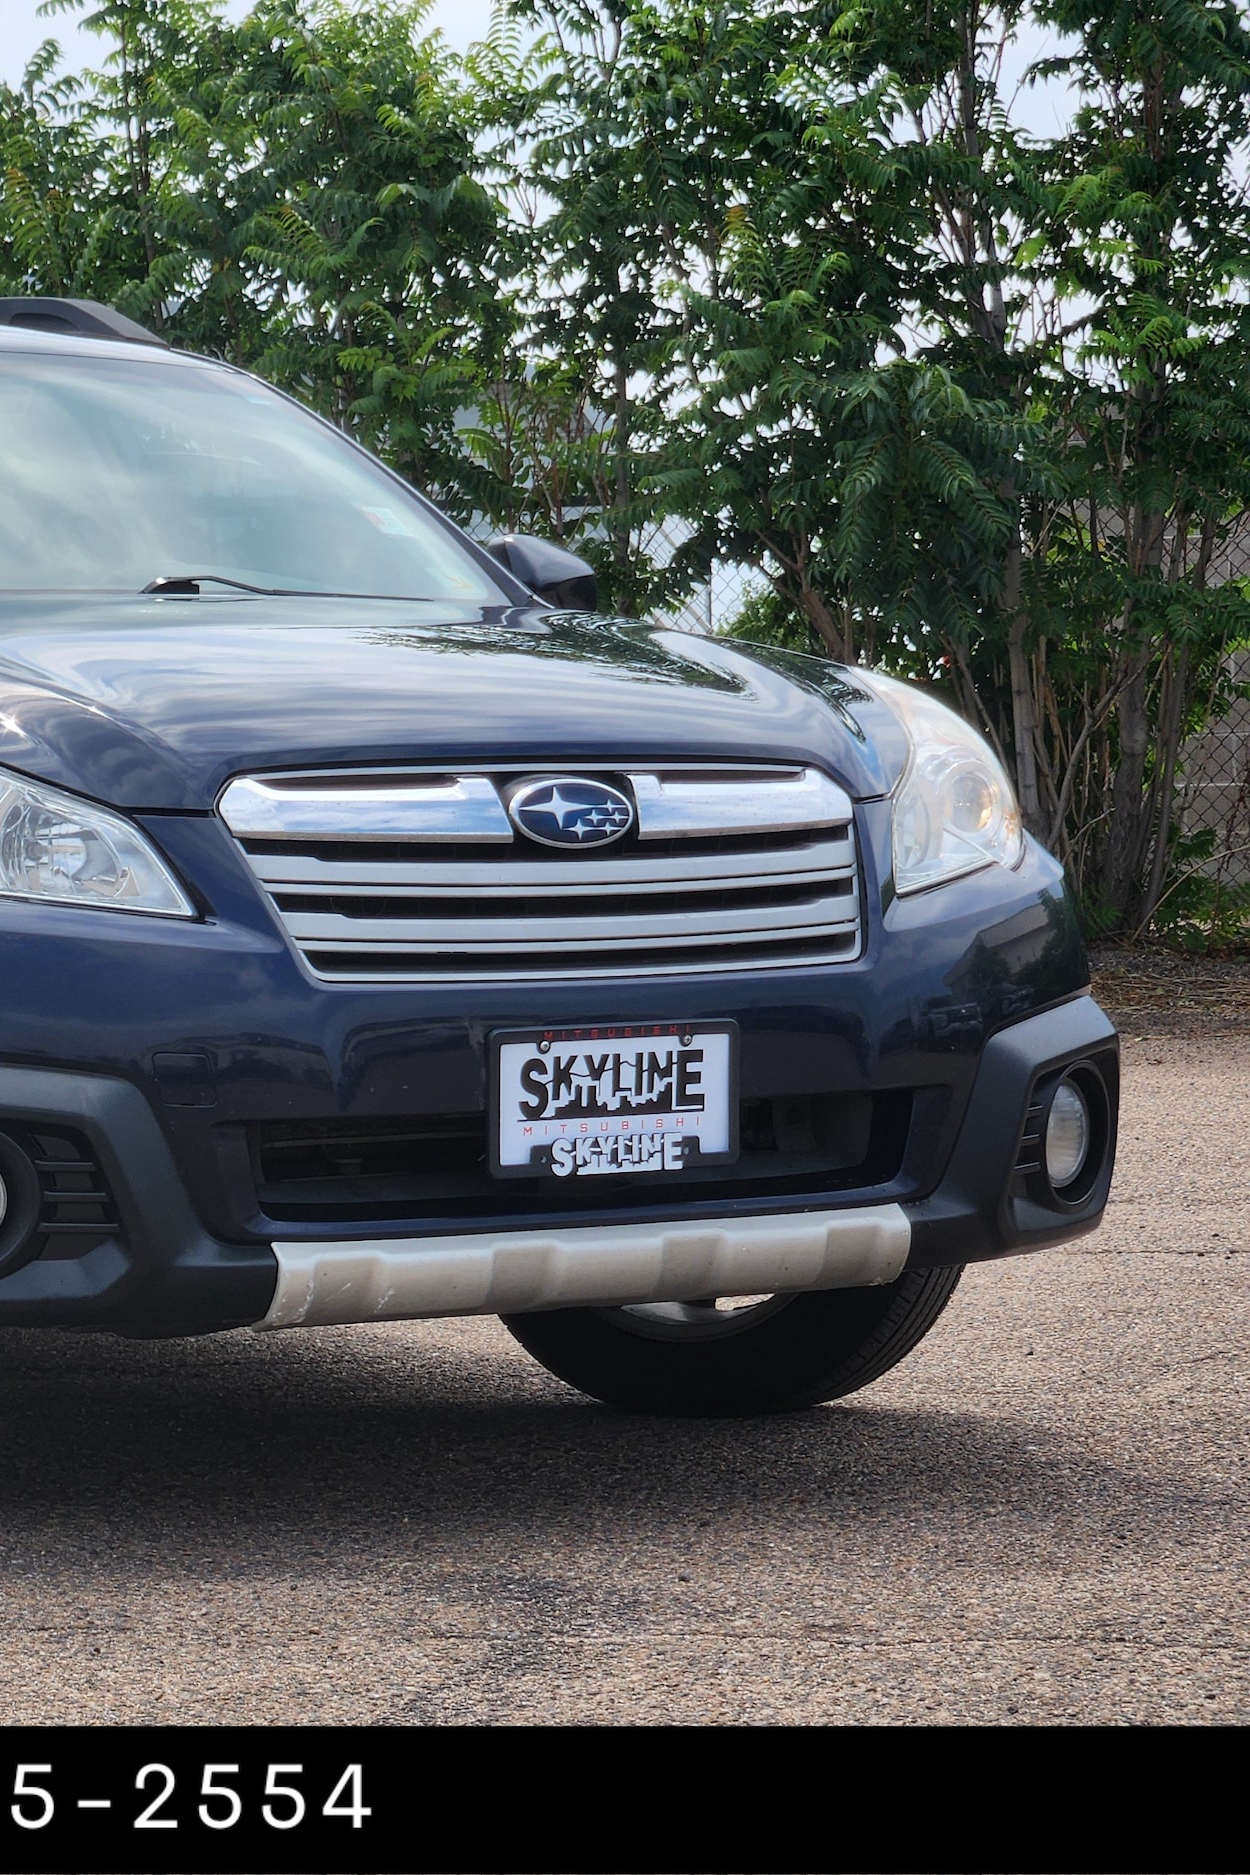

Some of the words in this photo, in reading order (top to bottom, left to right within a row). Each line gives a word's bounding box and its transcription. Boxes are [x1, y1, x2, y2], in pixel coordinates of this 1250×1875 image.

[543, 1024, 690, 1040] MITSUBISHI
[518, 1049, 704, 1121] SKYLINE
[523, 1116, 700, 1136] MITSUBISHI
[551, 1132, 683, 1176] SKYLINE
